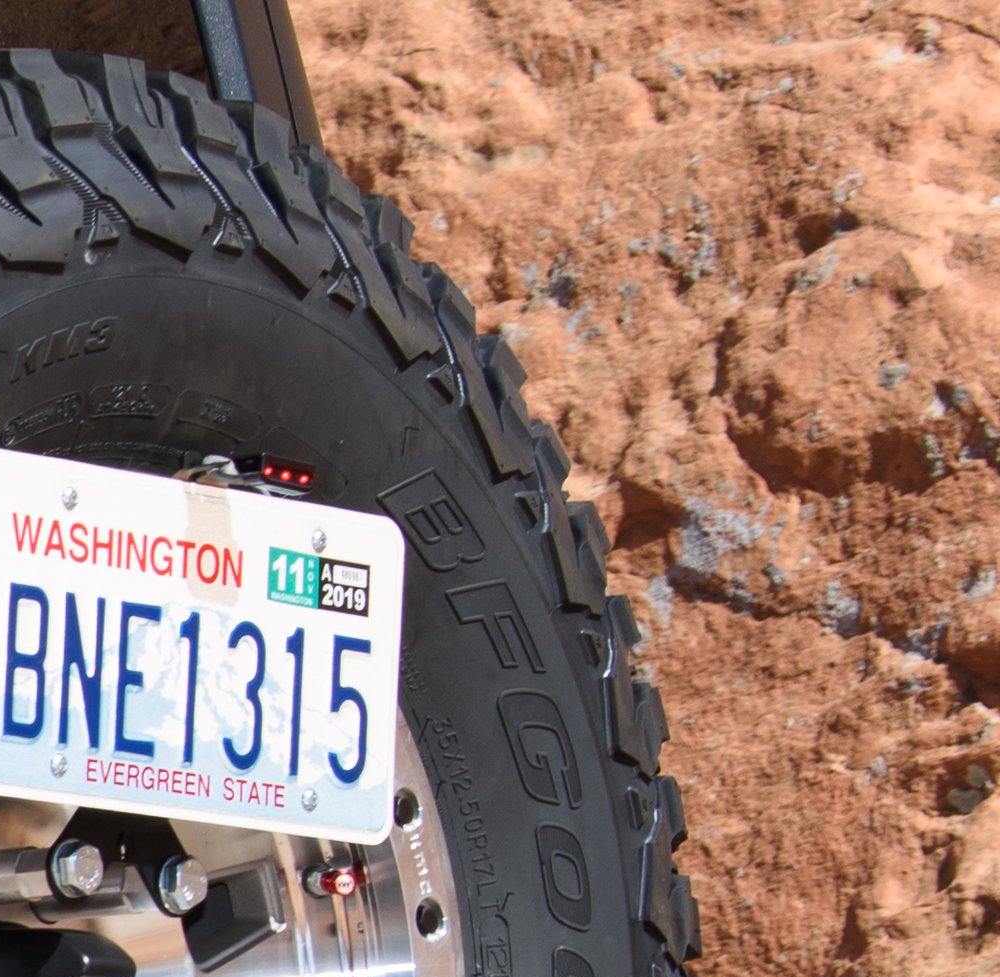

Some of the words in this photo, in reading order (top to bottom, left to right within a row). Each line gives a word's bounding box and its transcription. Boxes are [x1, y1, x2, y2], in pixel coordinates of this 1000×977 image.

[10, 315, 119, 384] KM3
[12, 512, 244, 588] WASHINGTON
[272, 553, 305, 595] 11
[321, 562, 332, 582] A
[321, 583, 366, 611] 2019
[2, 581, 372, 785] BNE1315
[85, 758, 211, 798] EVERGREEN
[222, 776, 286, 808] STATE
